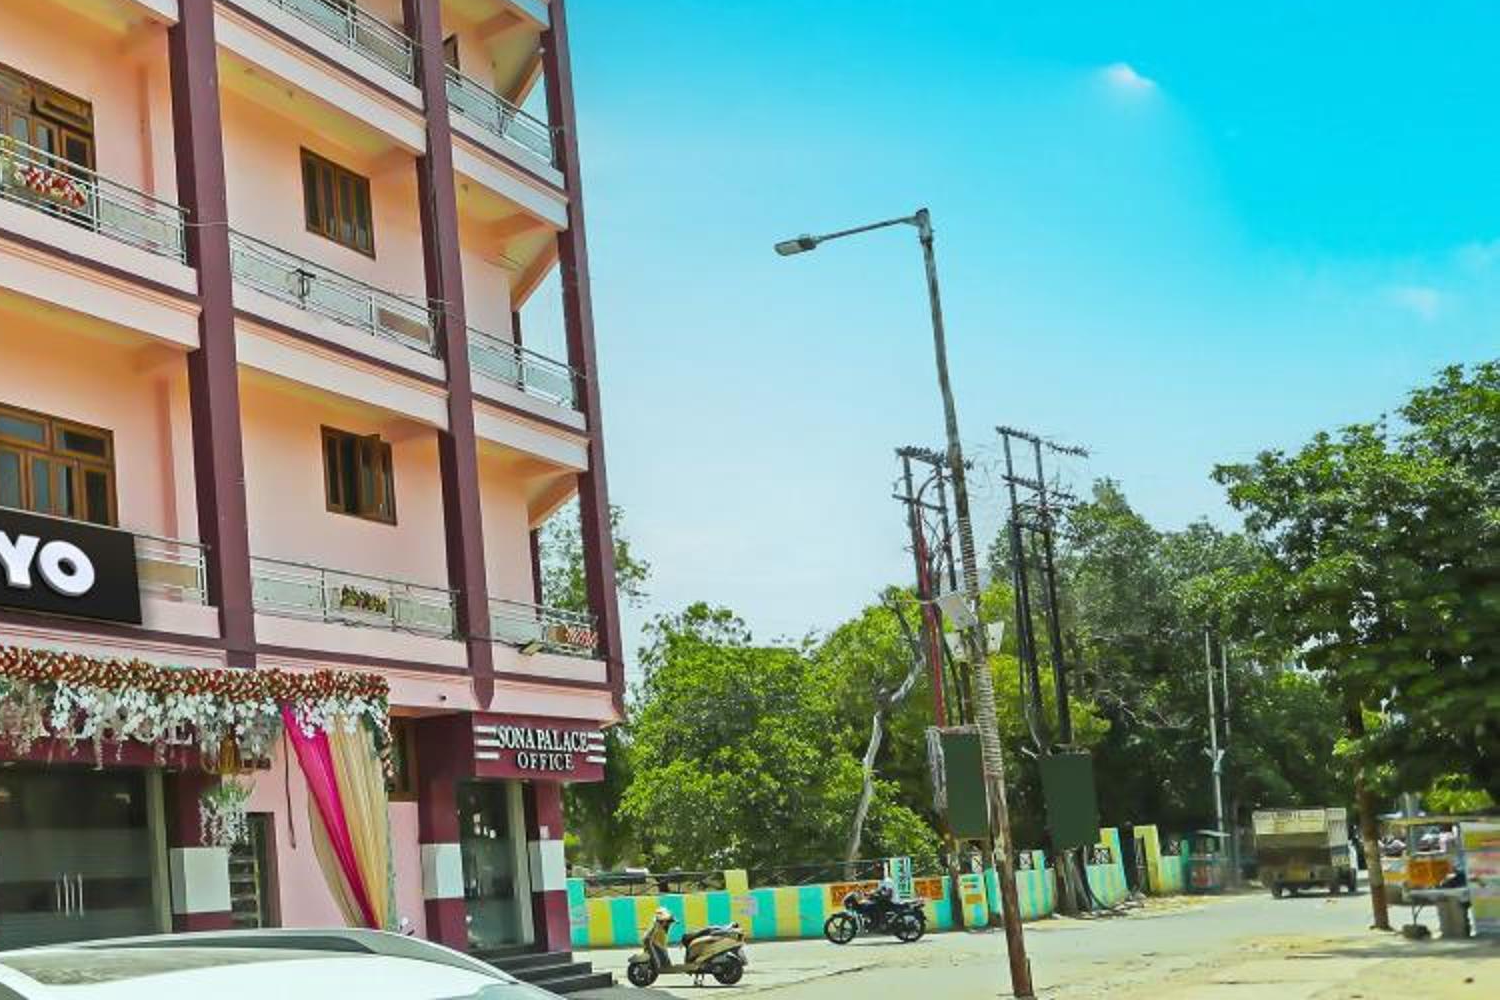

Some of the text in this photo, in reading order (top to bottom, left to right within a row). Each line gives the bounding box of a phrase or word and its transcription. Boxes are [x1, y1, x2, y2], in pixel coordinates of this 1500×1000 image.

[497, 725, 589, 752] SONA PALACE
[517, 752, 574, 770] OFFICE
